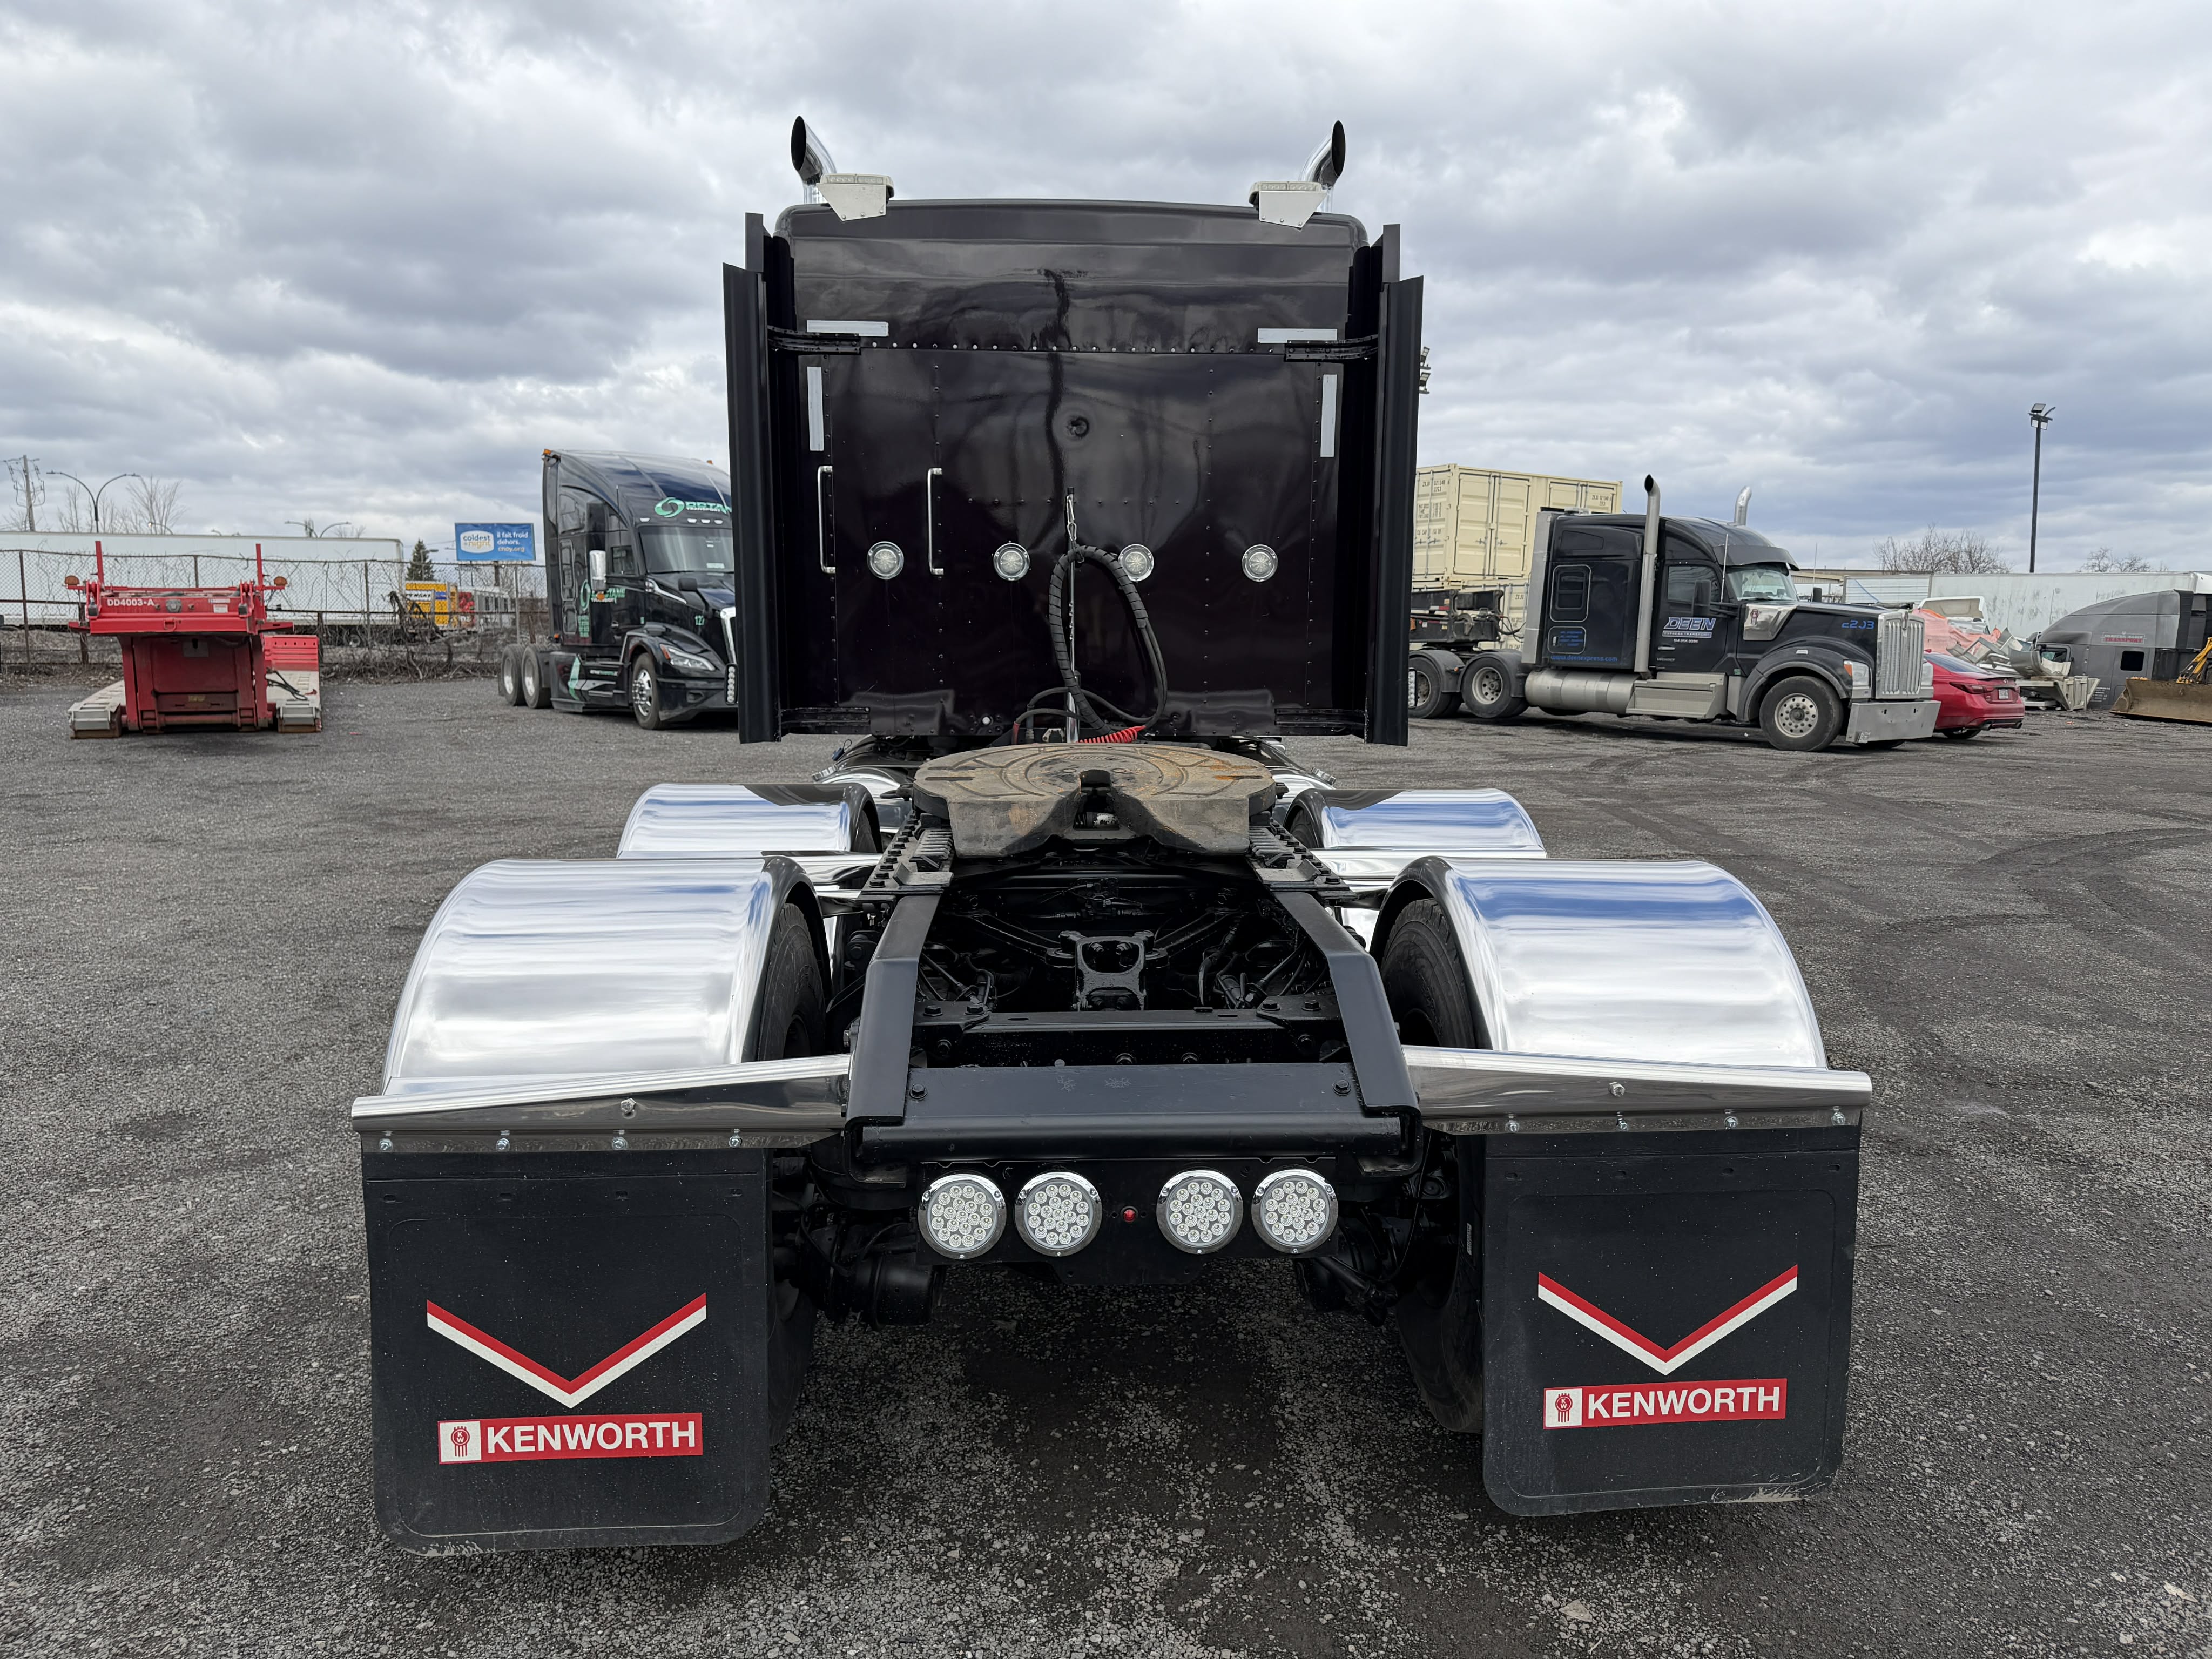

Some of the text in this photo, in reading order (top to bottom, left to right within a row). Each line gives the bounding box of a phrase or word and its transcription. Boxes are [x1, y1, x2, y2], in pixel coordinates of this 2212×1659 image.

[468, 541, 491, 549] night
[1663, 617, 1716, 631] DEEN
[1588, 1386, 1780, 1419] KENWORTH
[488, 1421, 695, 1453] KENWORTH
